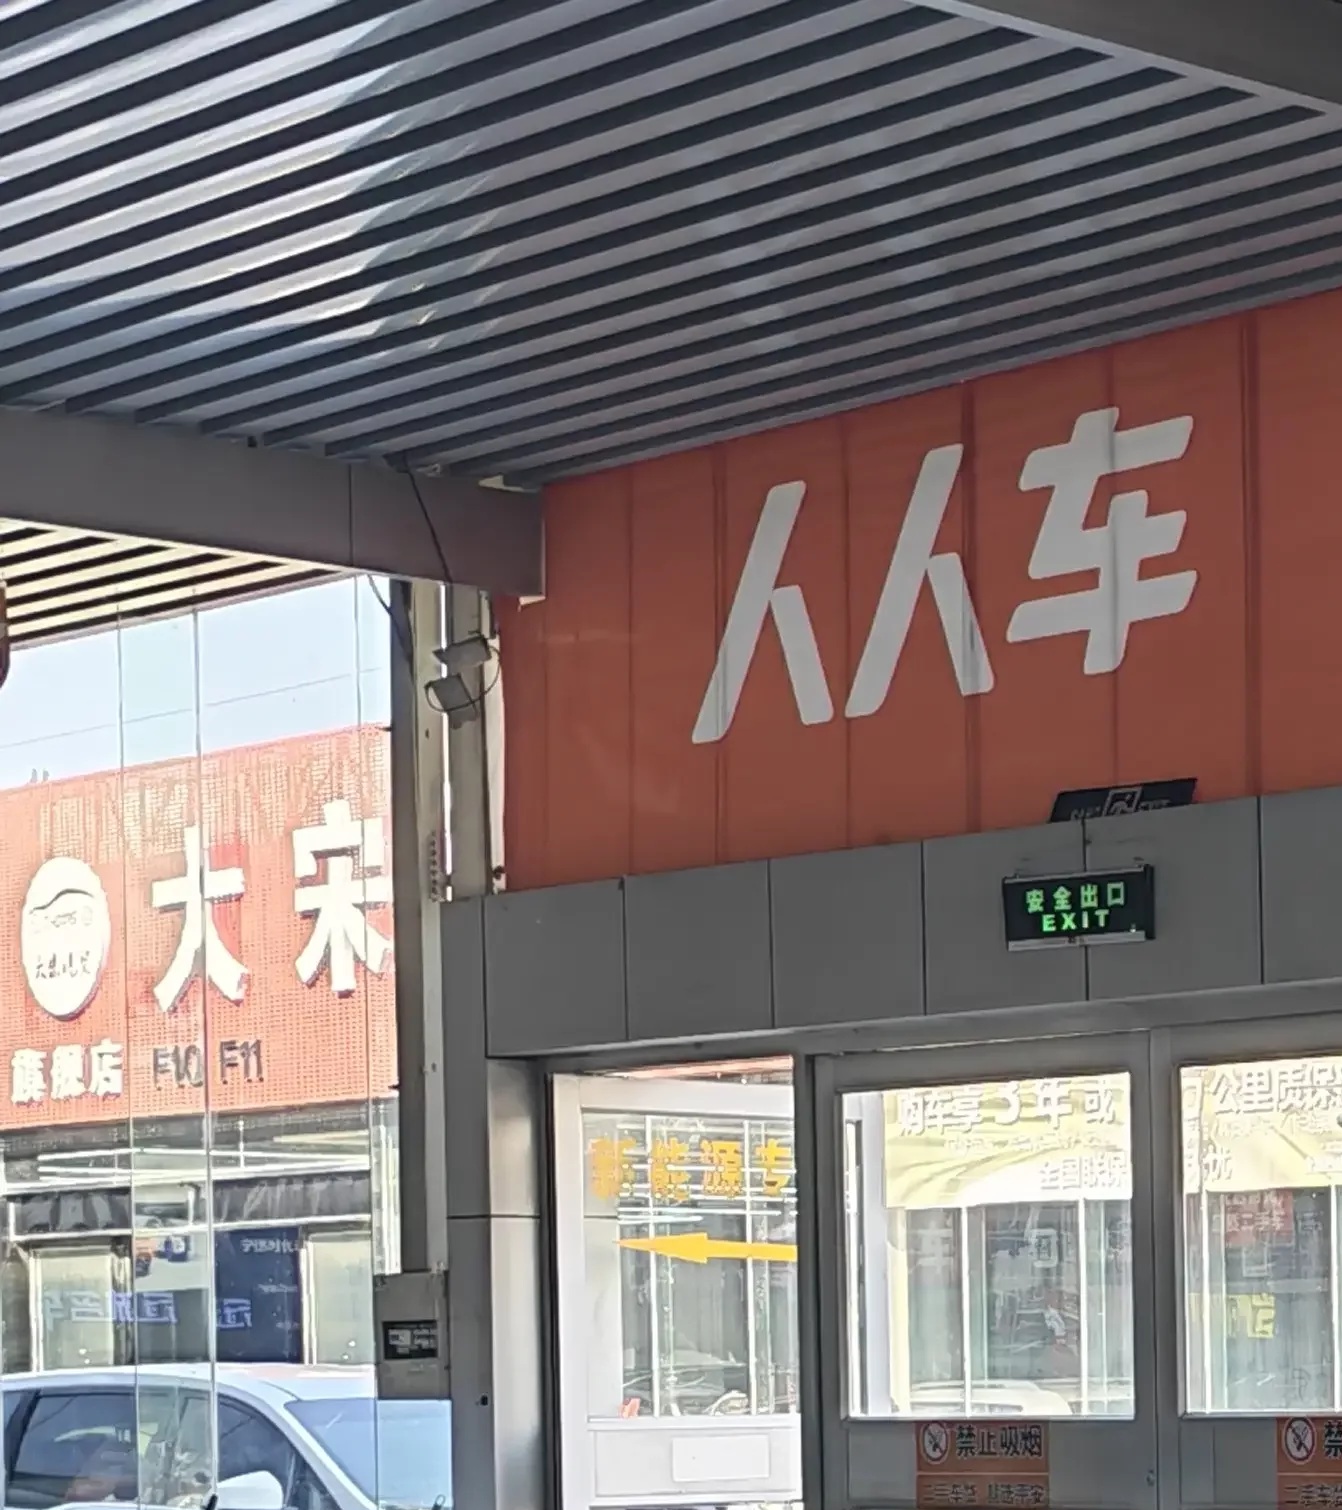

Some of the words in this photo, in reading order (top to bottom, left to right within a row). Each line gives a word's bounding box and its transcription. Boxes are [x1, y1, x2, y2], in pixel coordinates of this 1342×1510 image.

[692, 406, 1198, 744] 人人车
[1026, 881, 1125, 914] 安全出口
[1042, 908, 1110, 932] EXIT
[956, 1425, 1043, 1458] 禁止吸烟
